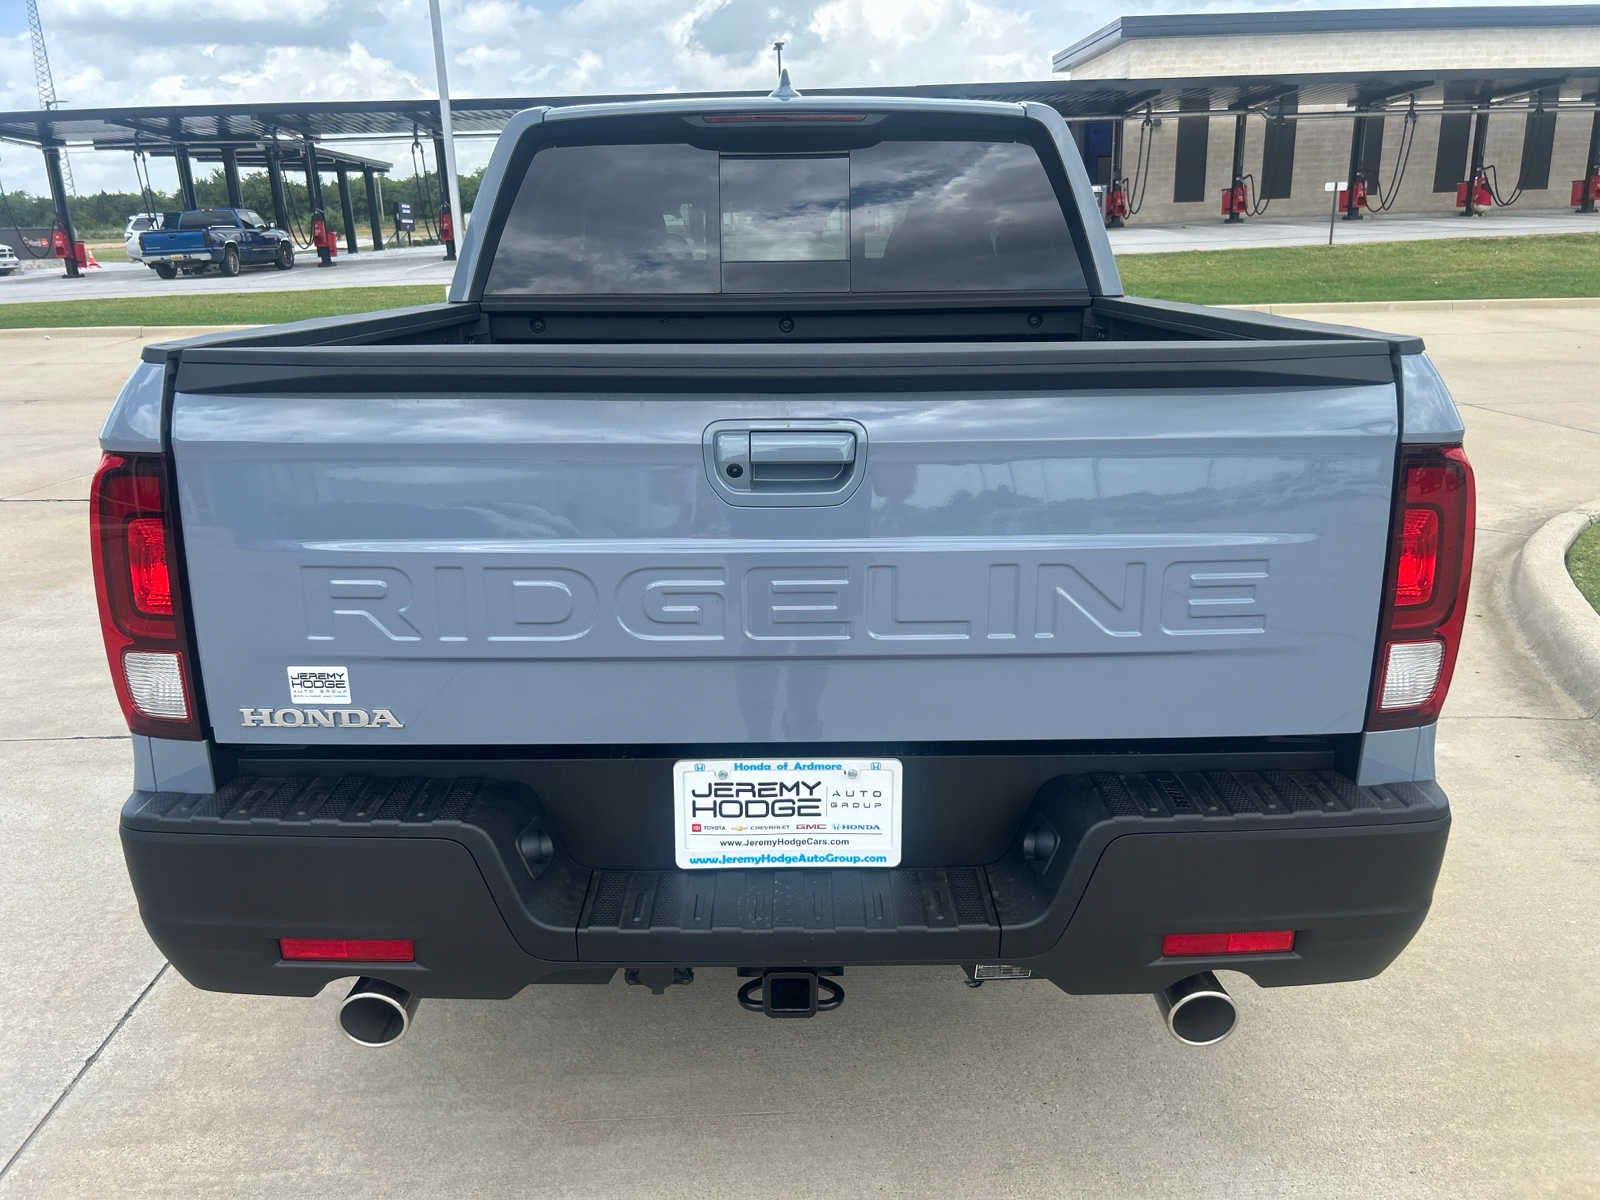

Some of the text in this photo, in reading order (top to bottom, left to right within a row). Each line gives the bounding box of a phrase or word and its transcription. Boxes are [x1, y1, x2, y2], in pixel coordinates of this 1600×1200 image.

[300, 559, 1270, 643] RIDGELINE
[290, 672, 345, 680] JEREMY
[291, 680, 347, 689] HODGE
[239, 708, 404, 729] HONDA
[733, 762, 842, 771] Honda of Ardmore
[691, 780, 822, 798] JEREMY
[832, 790, 882, 798] AUTO
[692, 798, 822, 818] HODGE
[719, 837, 850, 847] www.JeremyHodgeCars.com
[689, 853, 887, 865] www.JeremyHodgeAutoGroup.com
